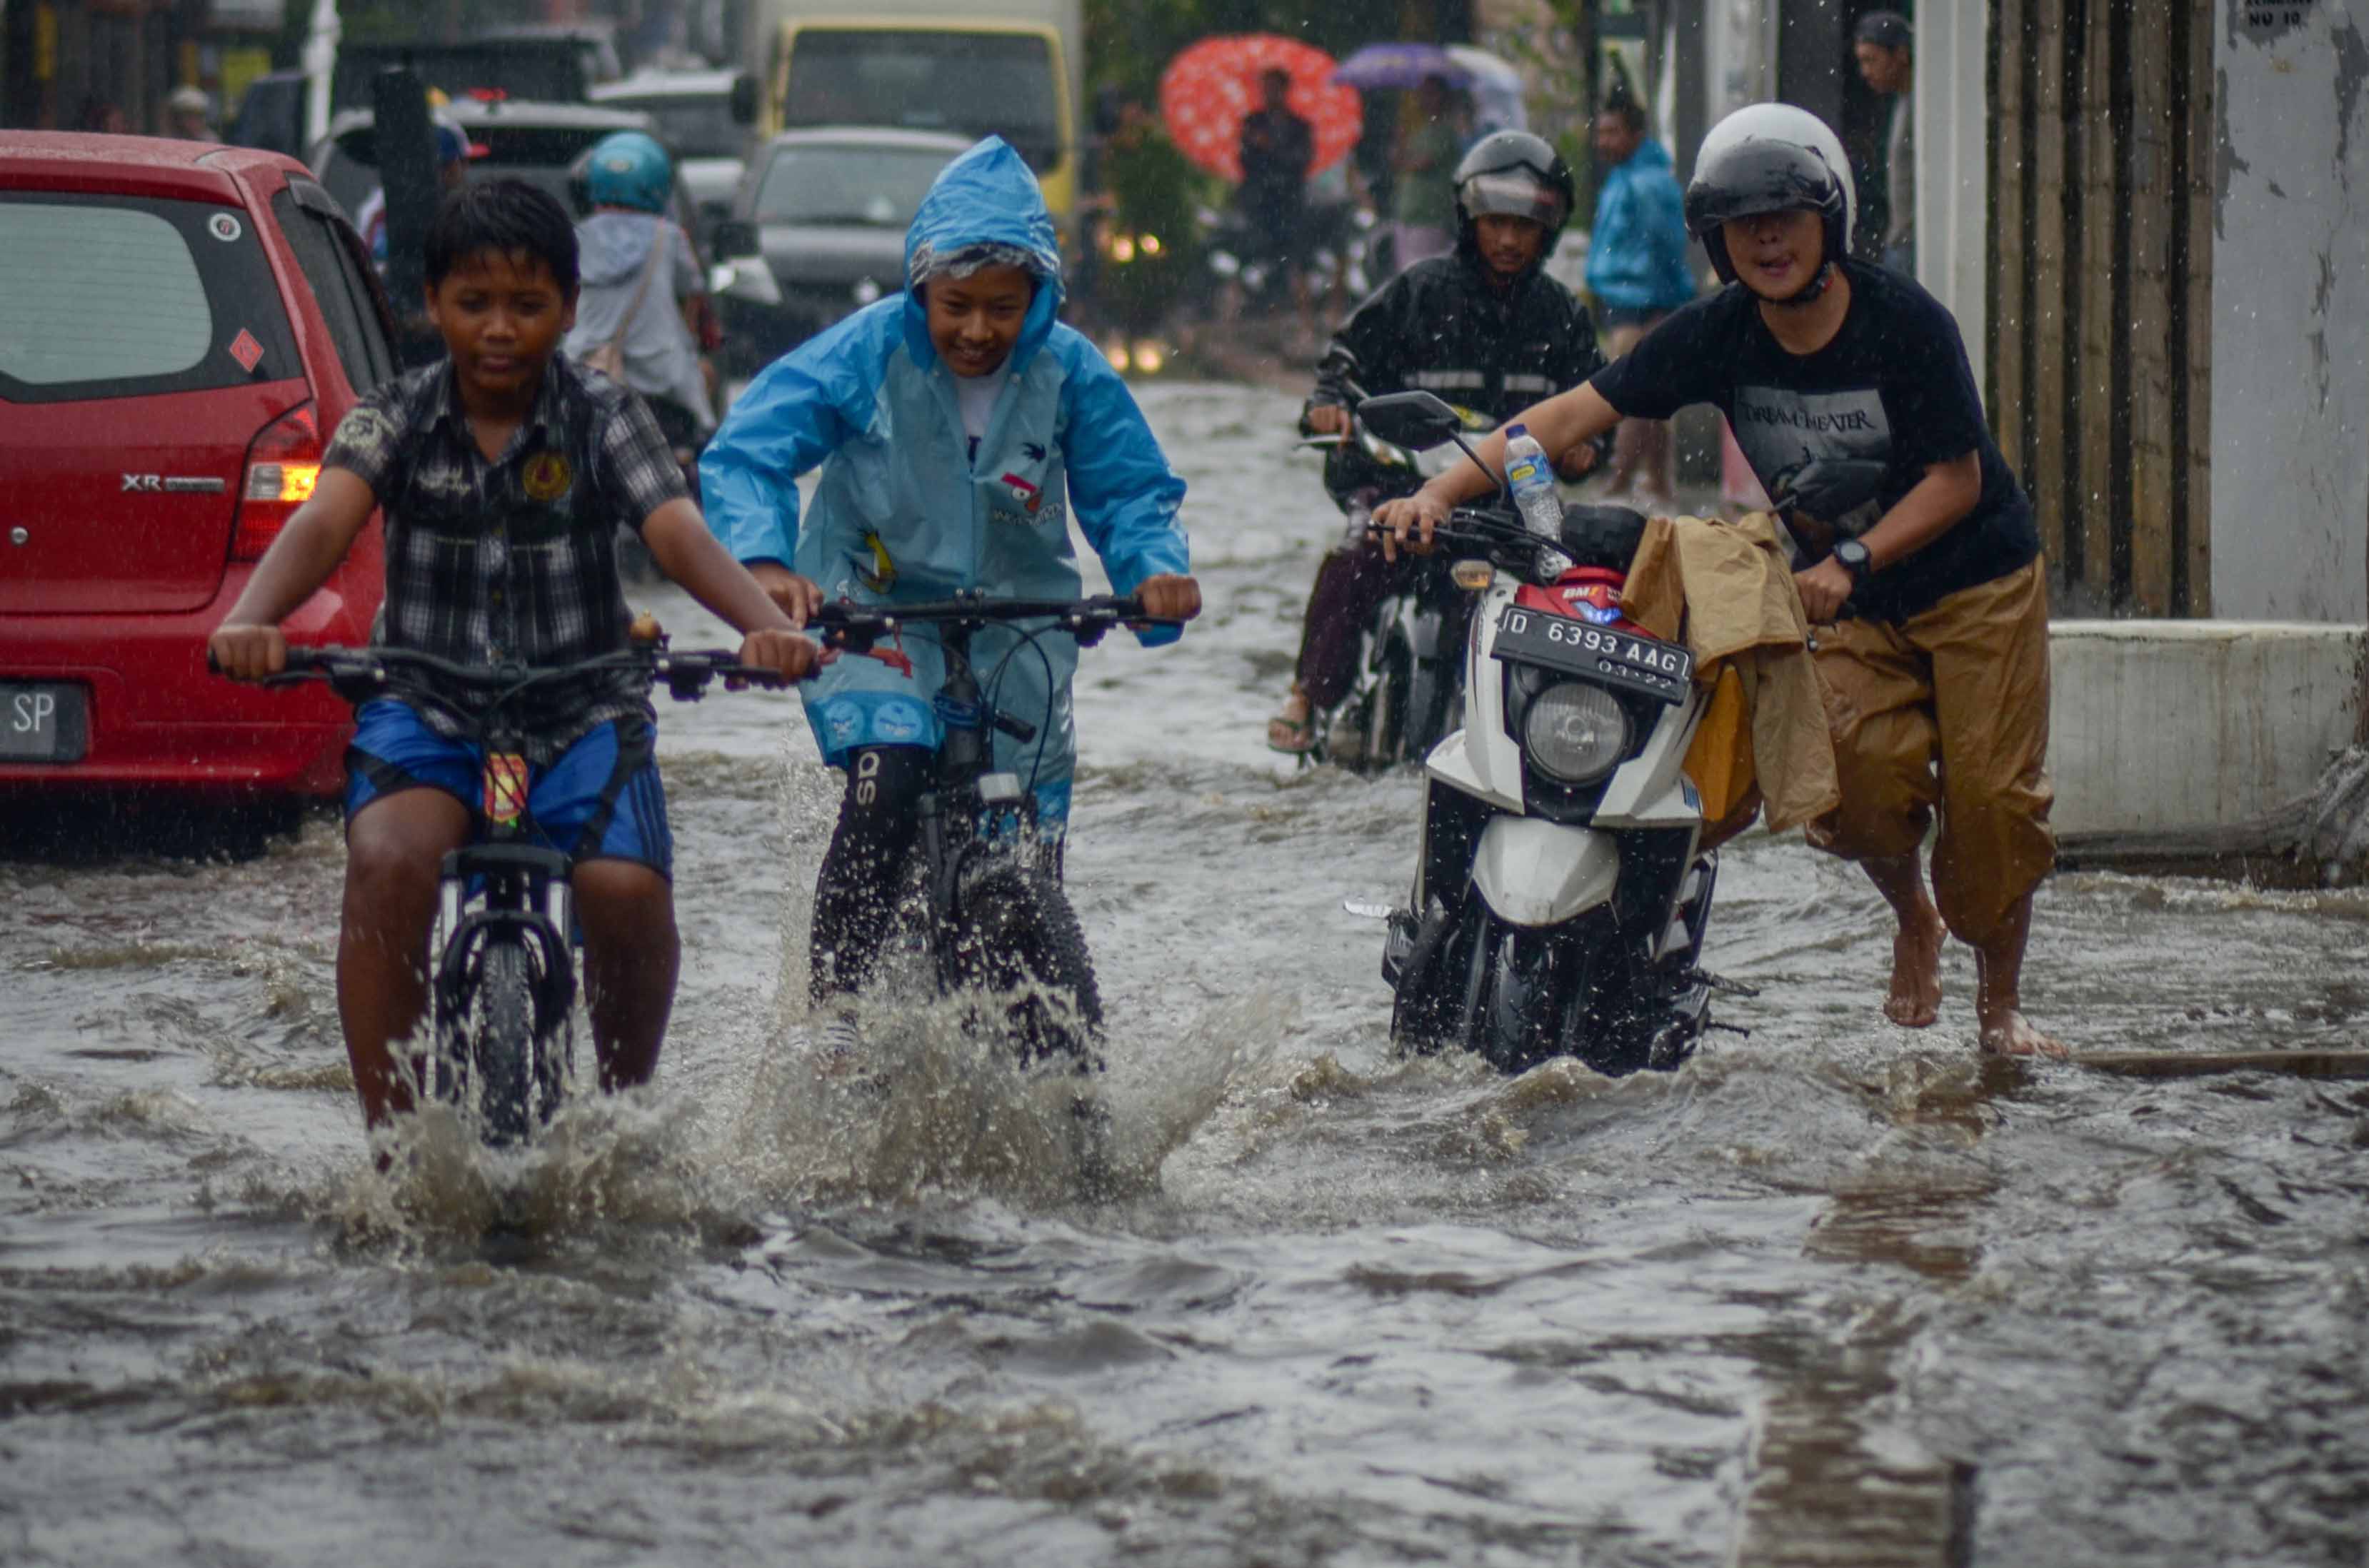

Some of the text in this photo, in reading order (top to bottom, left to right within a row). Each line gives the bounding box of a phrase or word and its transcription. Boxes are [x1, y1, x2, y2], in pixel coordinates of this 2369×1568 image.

[121, 473, 162, 492] XR
[1511, 613, 1527, 634] D
[1548, 622, 1618, 654] 6393
[1626, 643, 1678, 672] AAG
[14, 692, 55, 732] SP
